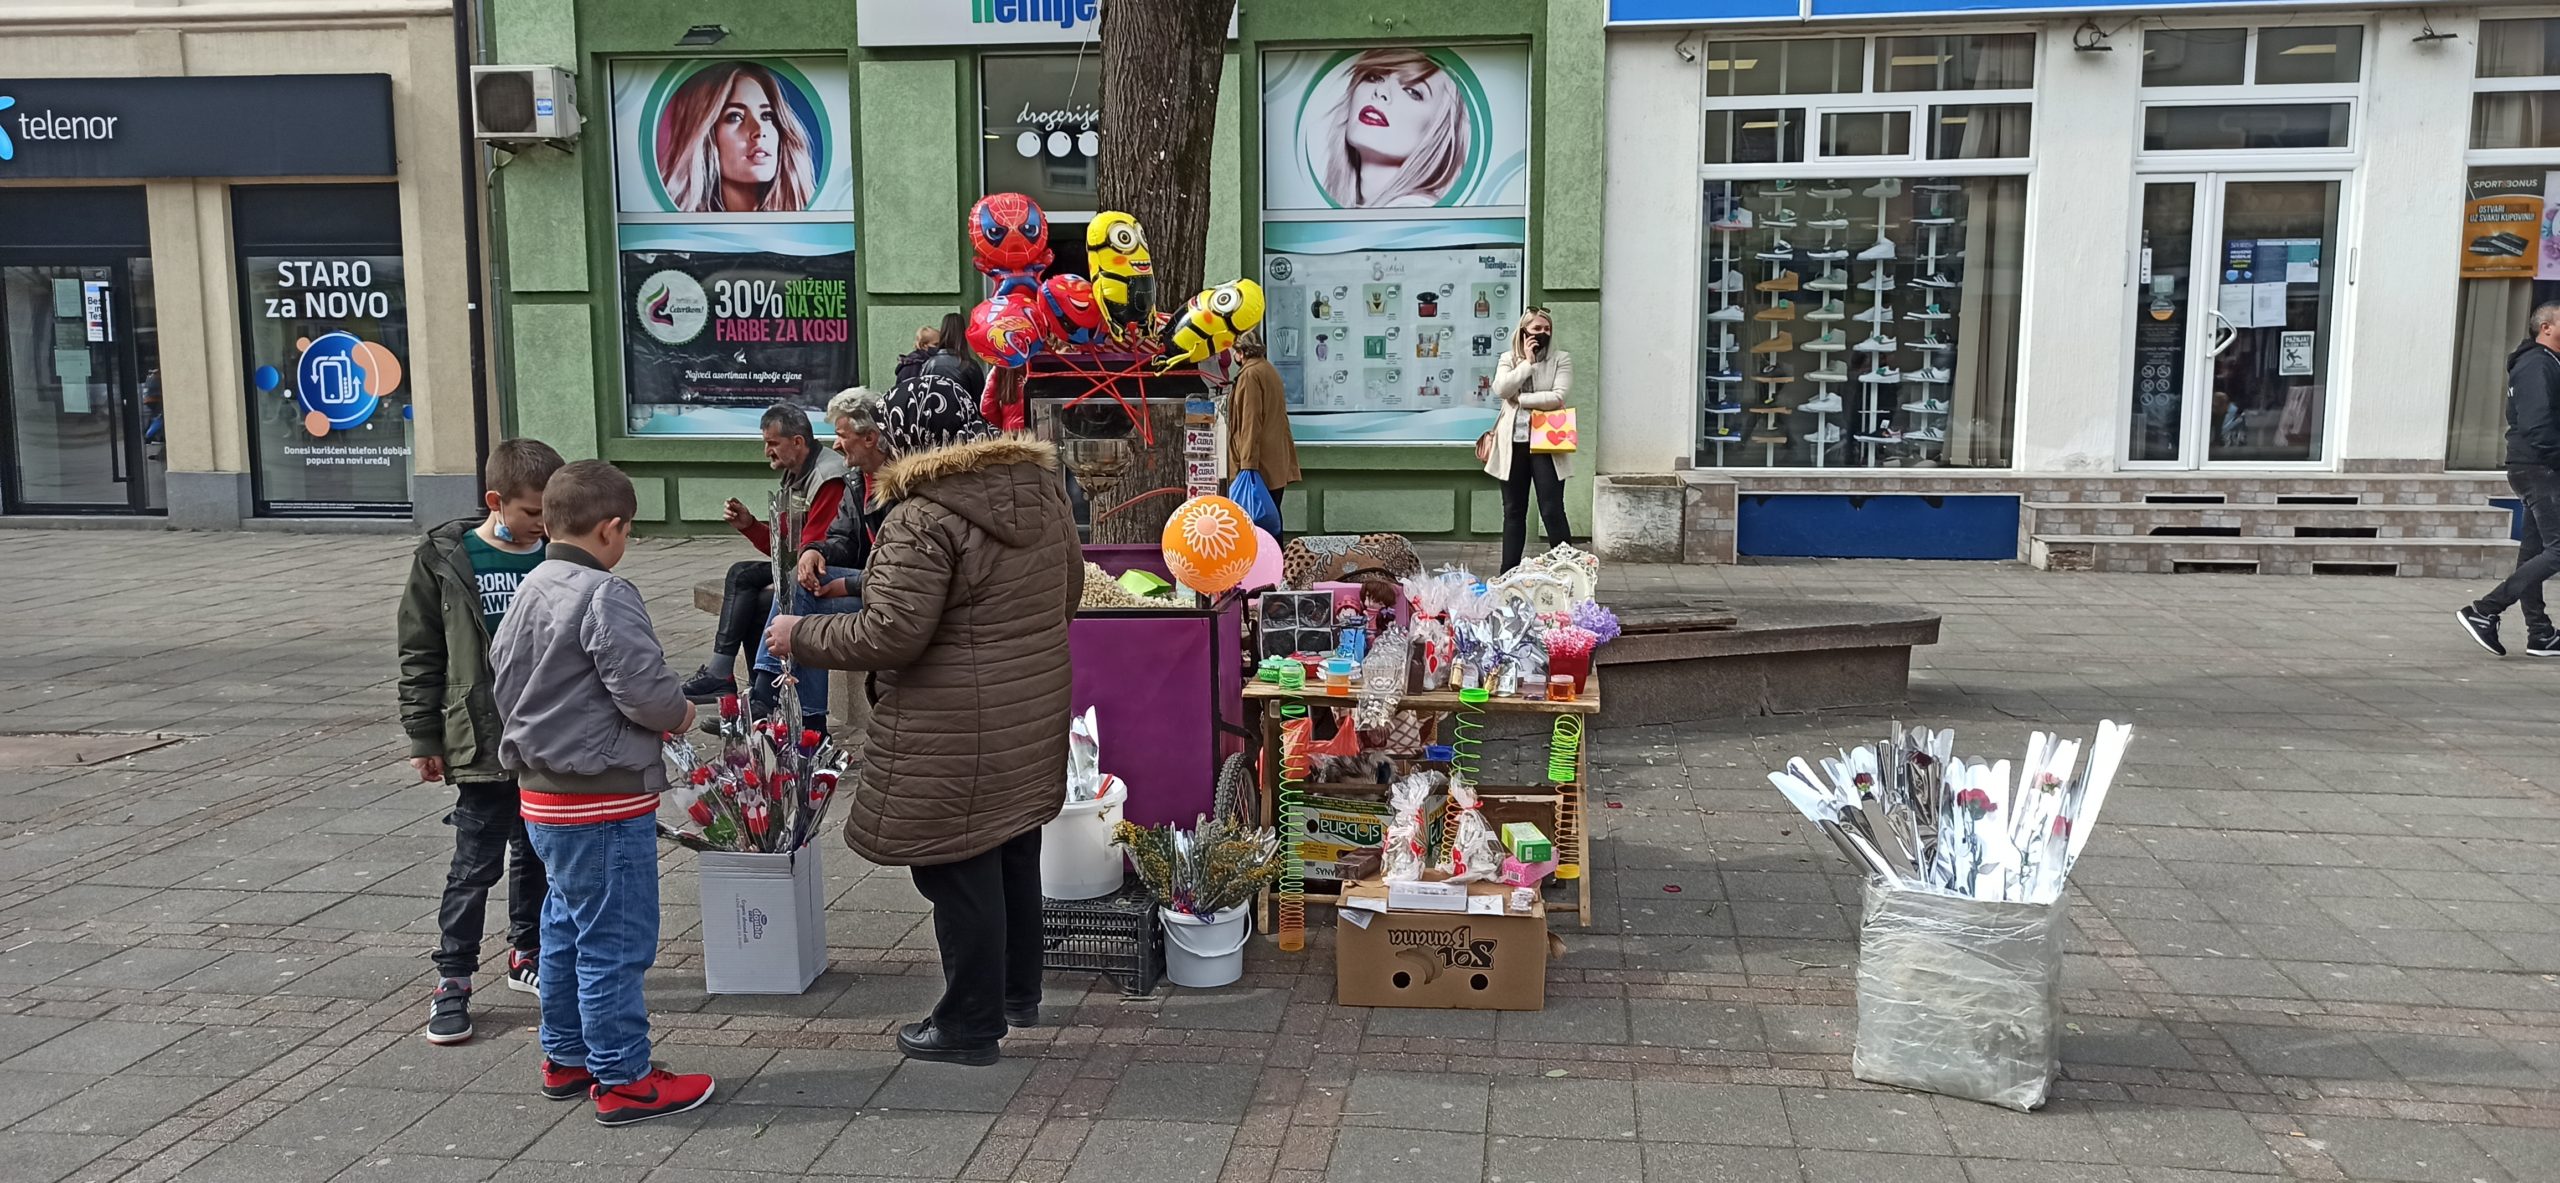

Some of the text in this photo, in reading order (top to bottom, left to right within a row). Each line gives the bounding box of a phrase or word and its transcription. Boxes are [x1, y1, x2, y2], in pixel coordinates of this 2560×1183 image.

[18, 109, 118, 140] telenor
[1016, 101, 1099, 131] drogerija
[2479, 214, 2500, 222] SVAKU
[278, 260, 371, 287] STARO
[784, 277, 846, 296] SNIŽENJE
[265, 291, 389, 318] za NOVO
[714, 279, 847, 319] 30% NA SVE
[716, 319, 848, 342] FARBE ZA KOSU
[712, 371, 748, 380] asortiman
[284, 446, 311, 455] Donesi
[311, 446, 347, 455] korišćeni
[348, 446, 377, 455] telefon
[382, 446, 412, 457] dobijaš
[306, 457, 334, 466] popust
[346, 456, 363, 465] novi
[364, 456, 391, 467] uređaj
[1320, 820, 1380, 842] slobana
[1388, 925, 1471, 950] Banana
